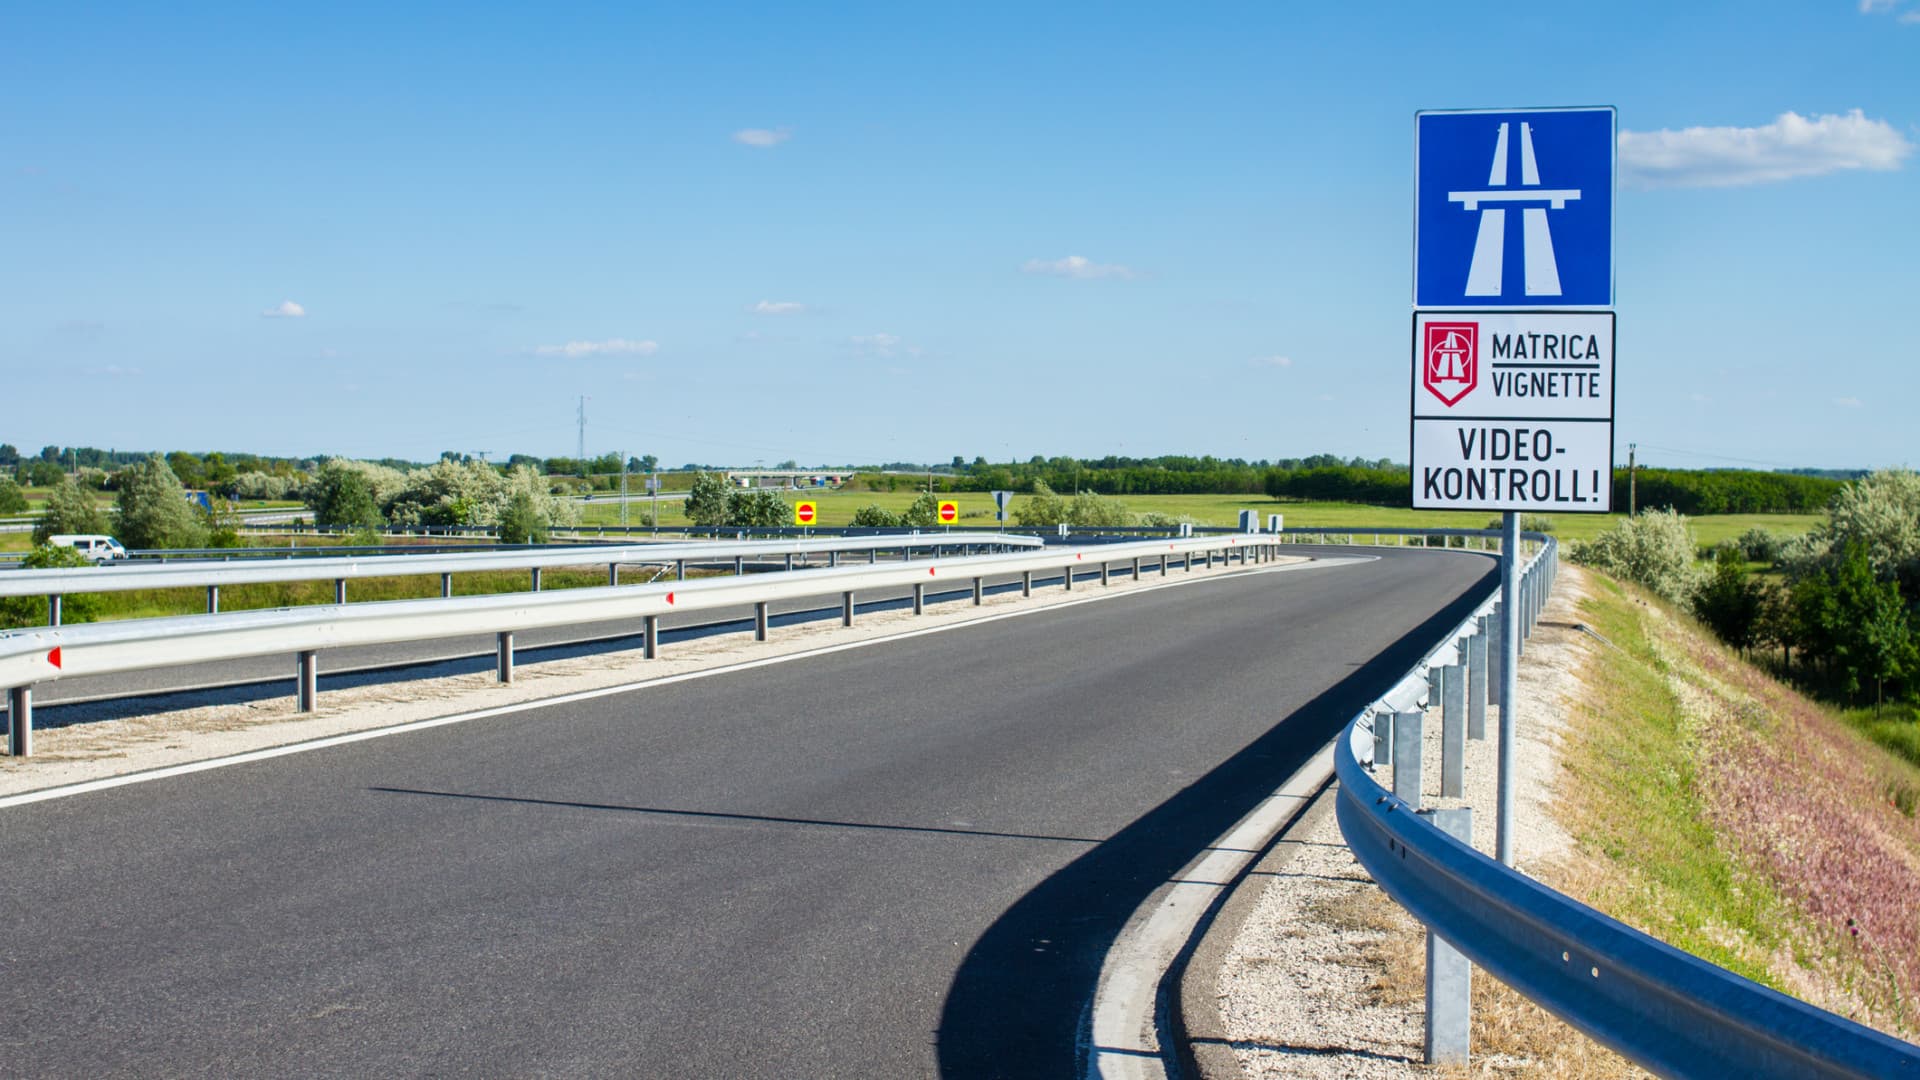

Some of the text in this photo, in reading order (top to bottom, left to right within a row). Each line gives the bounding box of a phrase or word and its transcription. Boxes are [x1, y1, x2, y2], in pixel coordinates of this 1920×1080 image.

[1492, 334, 1600, 360] MATRICA
[1492, 372, 1600, 398] VIGNETTE
[1458, 428, 1566, 462] VIDEO-
[1424, 467, 1599, 502] KONTROLL!
